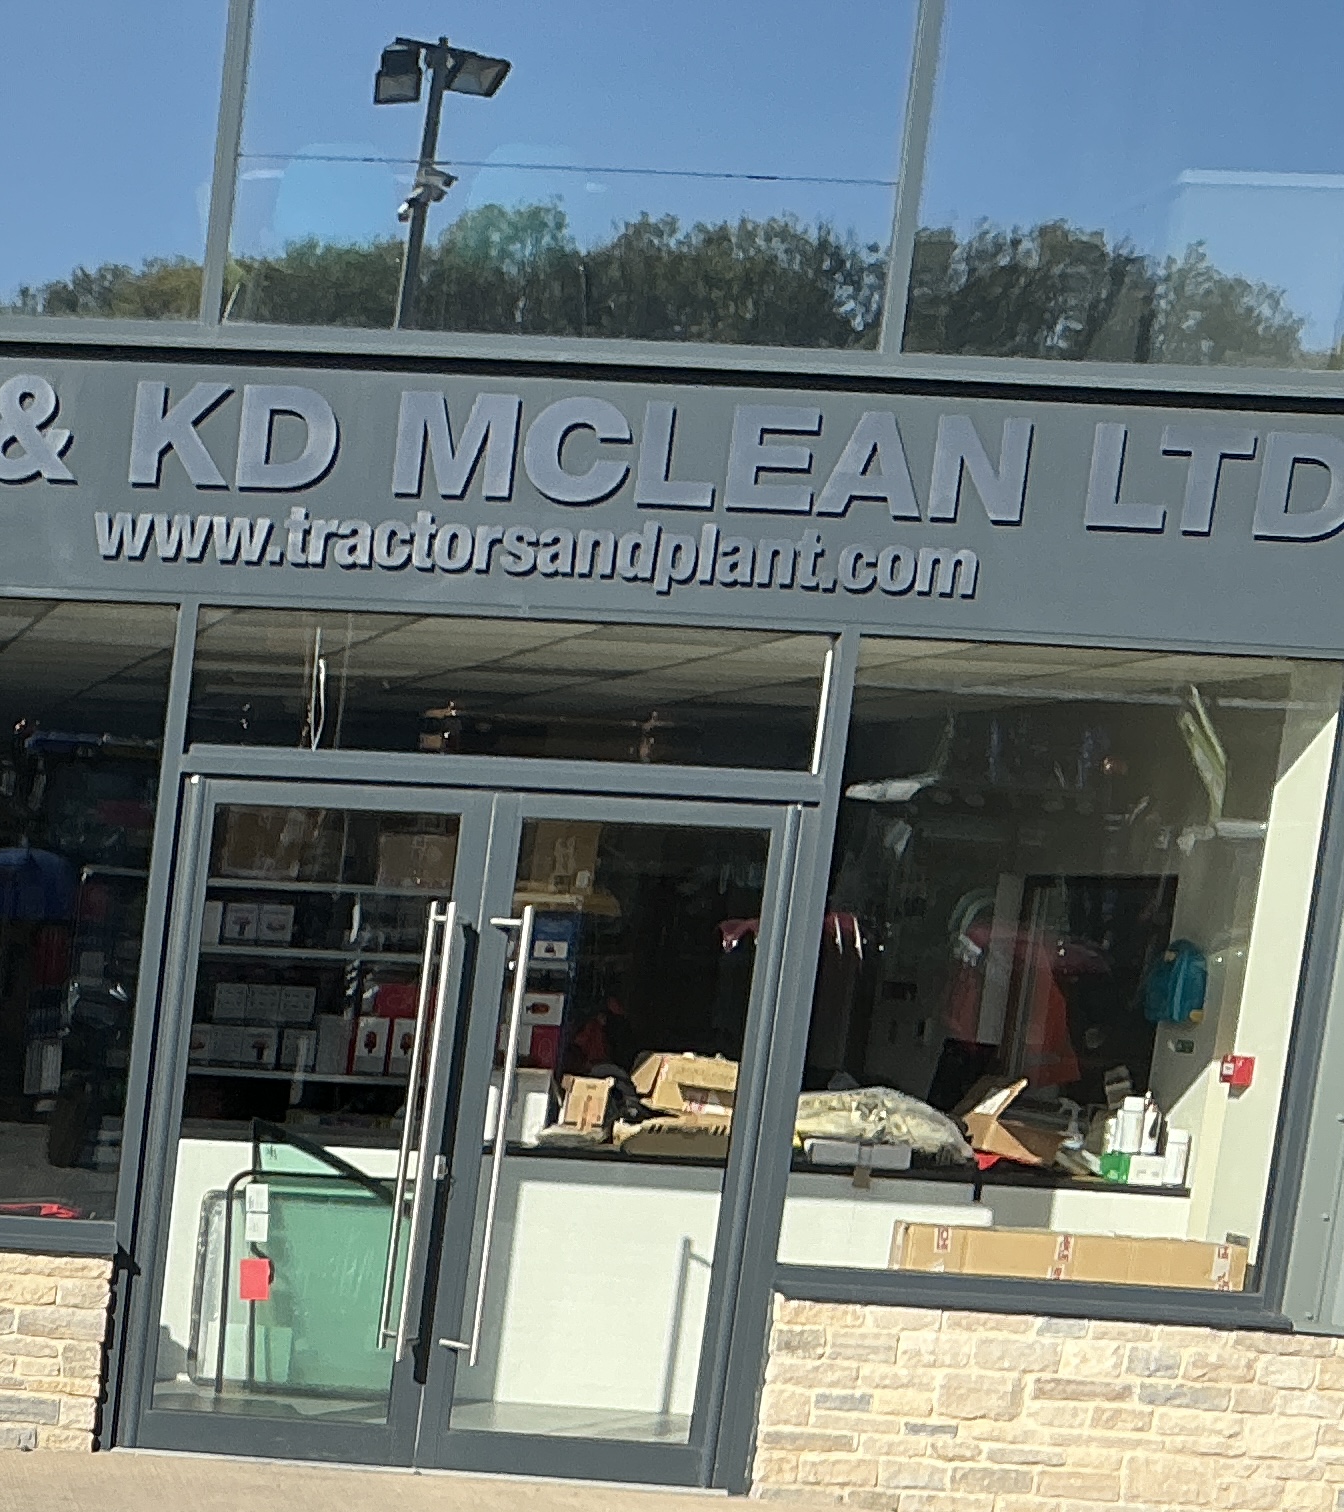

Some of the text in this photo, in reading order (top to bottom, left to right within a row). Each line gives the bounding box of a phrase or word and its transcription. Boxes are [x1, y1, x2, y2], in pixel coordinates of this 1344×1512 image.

[127, 380, 341, 493] KD
[391, 390, 1037, 527] MCLEAN
[1084, 422, 1344, 543] LTD
[93, 506, 980, 599] www.tractorsandplant.com
